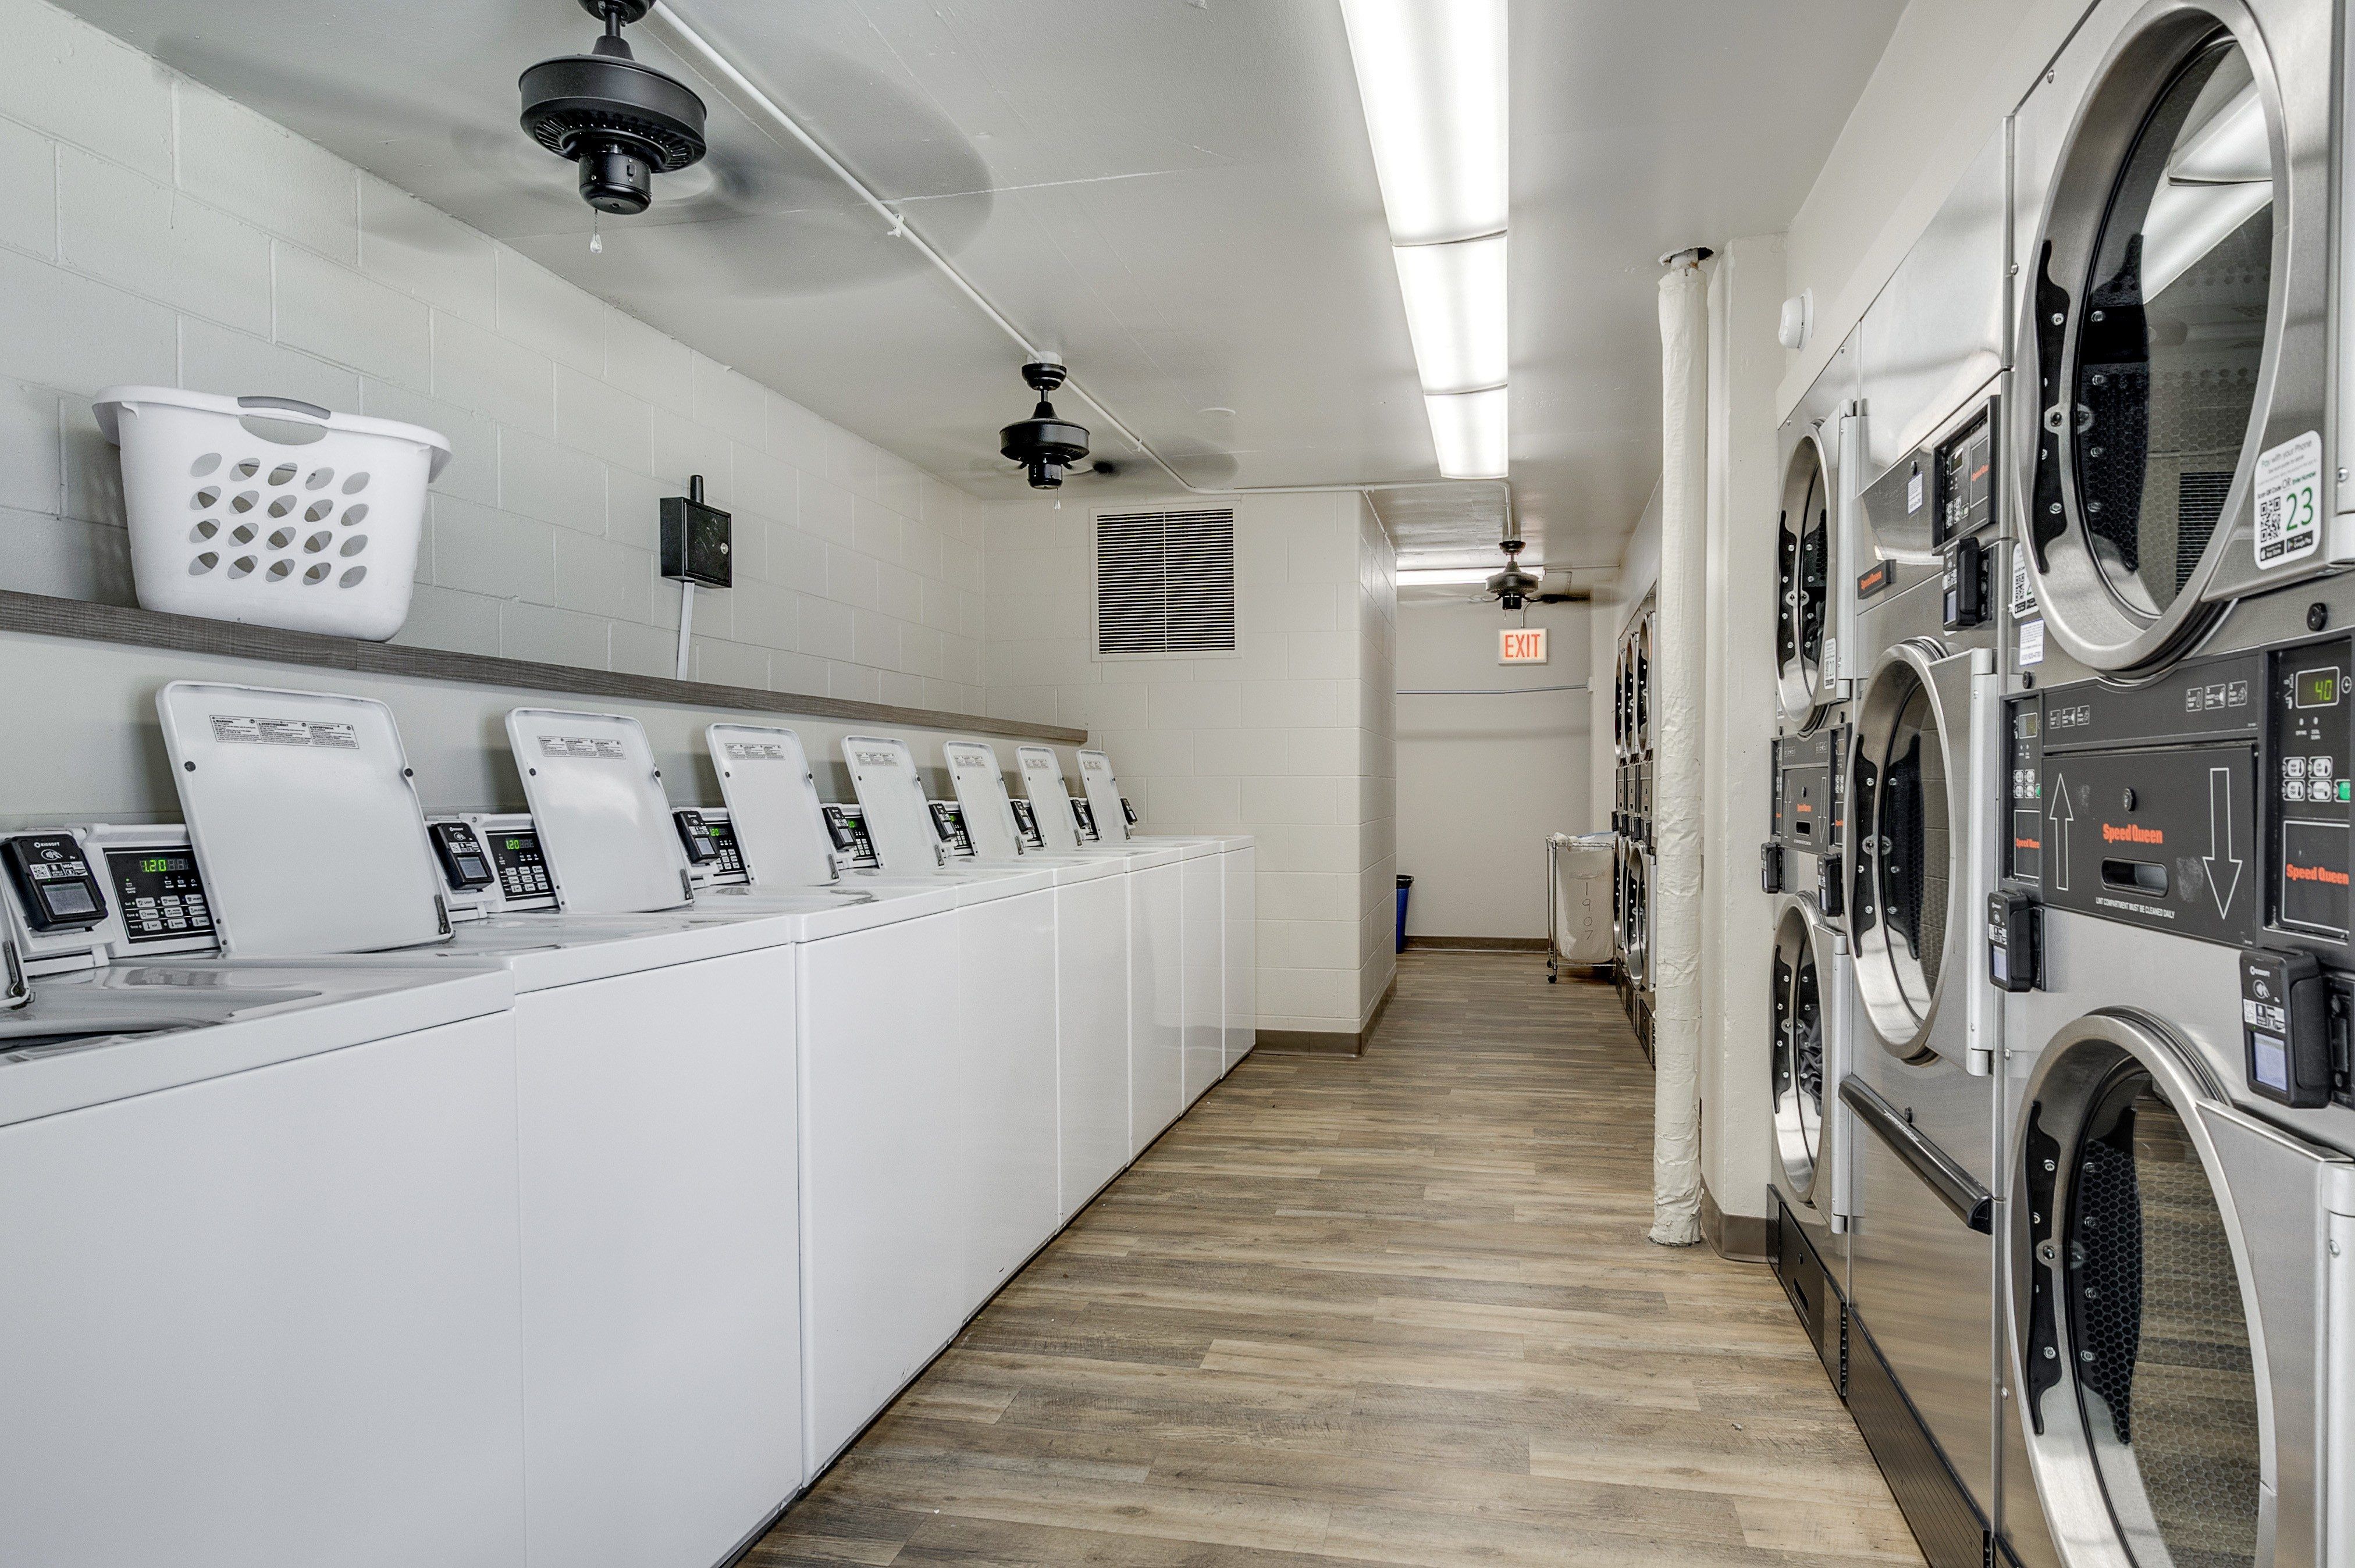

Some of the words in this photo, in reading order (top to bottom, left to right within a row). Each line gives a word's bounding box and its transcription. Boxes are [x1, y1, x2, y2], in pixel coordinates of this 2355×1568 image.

[2286, 487, 2314, 532] 23
[1505, 634, 1541, 658] EXIT
[2315, 679, 2332, 701] 40
[2016, 838, 2029, 849] Speed
[2103, 824, 2132, 843] Speed
[2132, 824, 2163, 844] Queen
[143, 858, 166, 872] 1.20
[2286, 863, 2317, 882] Speed
[2318, 866, 2349, 885] Queen
[2103, 898, 2129, 910] COMPARTMENT
[2129, 903, 2139, 912] MUST
[2139, 904, 2145, 913] BE
[2145, 906, 2163, 917] CLEANED
[2163, 909, 2175, 920] DAILY
